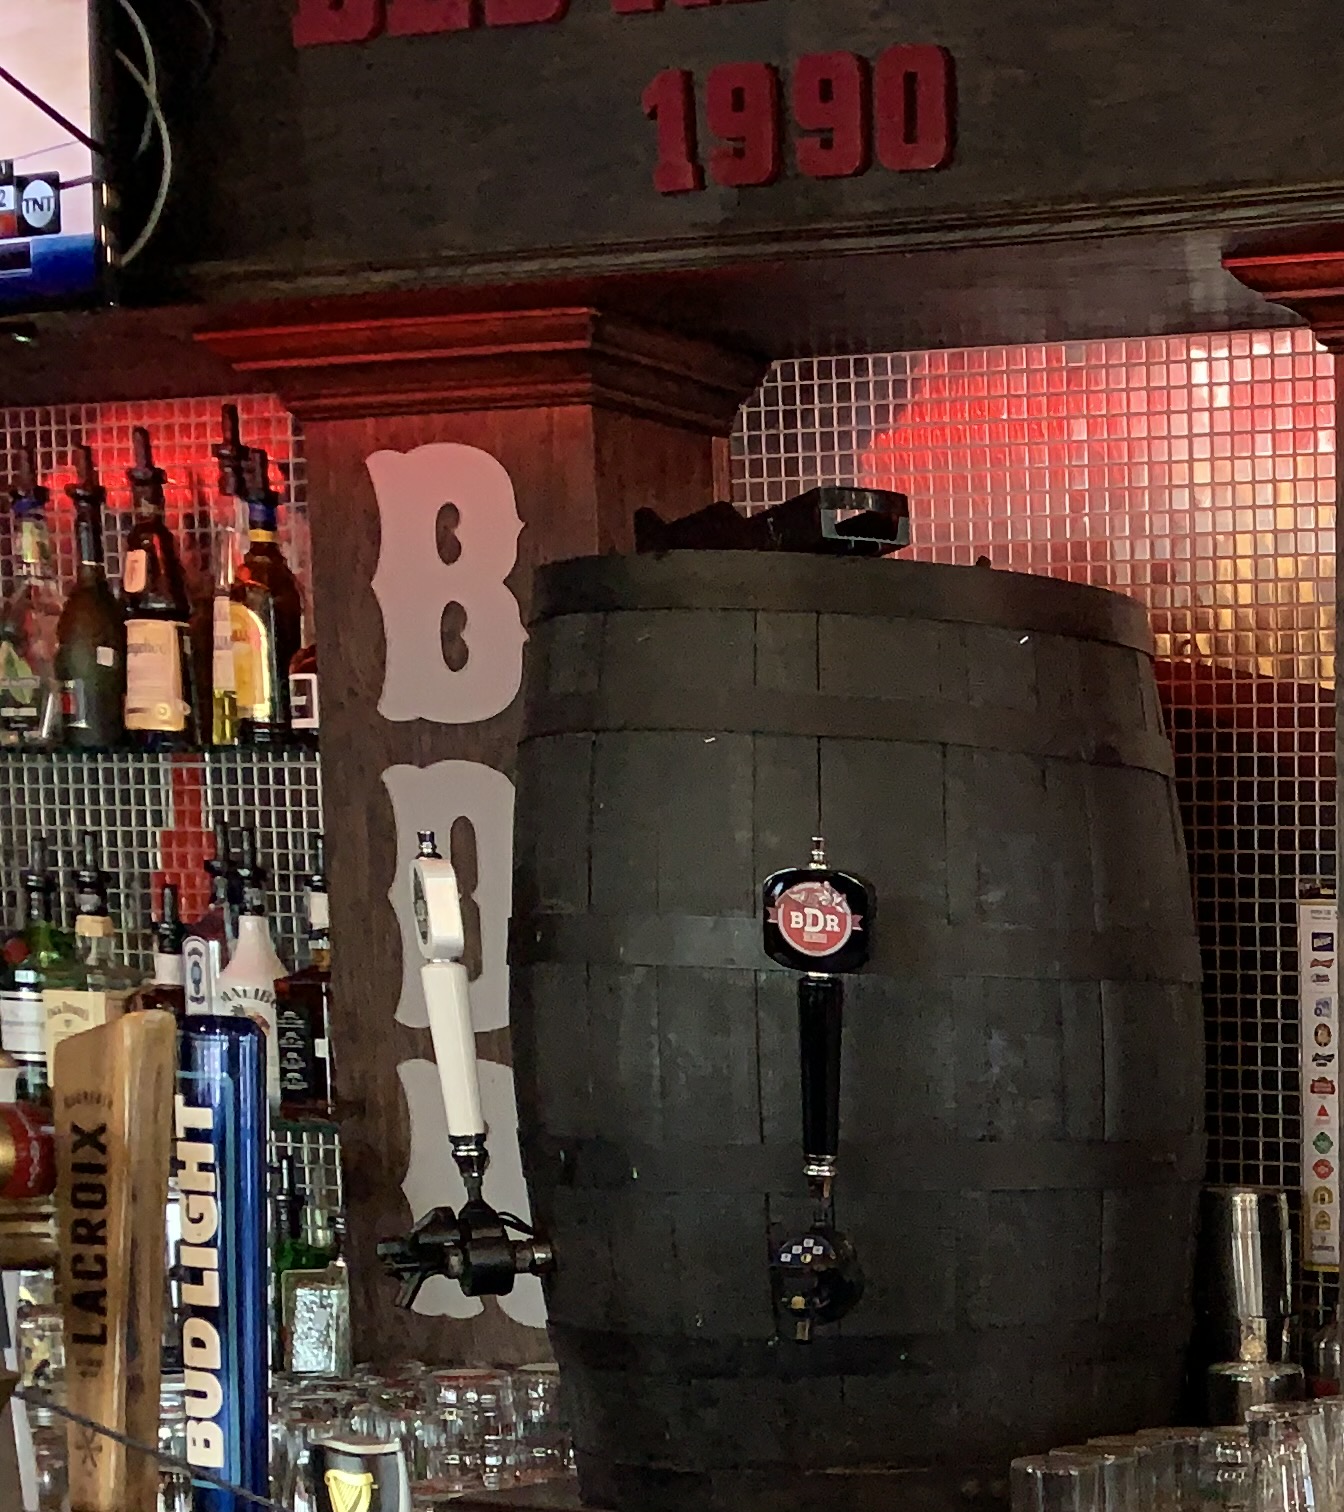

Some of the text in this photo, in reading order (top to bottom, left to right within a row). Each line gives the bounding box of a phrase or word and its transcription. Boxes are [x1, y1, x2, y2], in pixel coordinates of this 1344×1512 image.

[642, 43, 958, 194] 1990
[23, 195, 55, 214] TNT
[790, 907, 841, 933] BDR
[71, 1121, 107, 1347] LACROIX
[175, 1093, 225, 1469] BUD LIGHT
